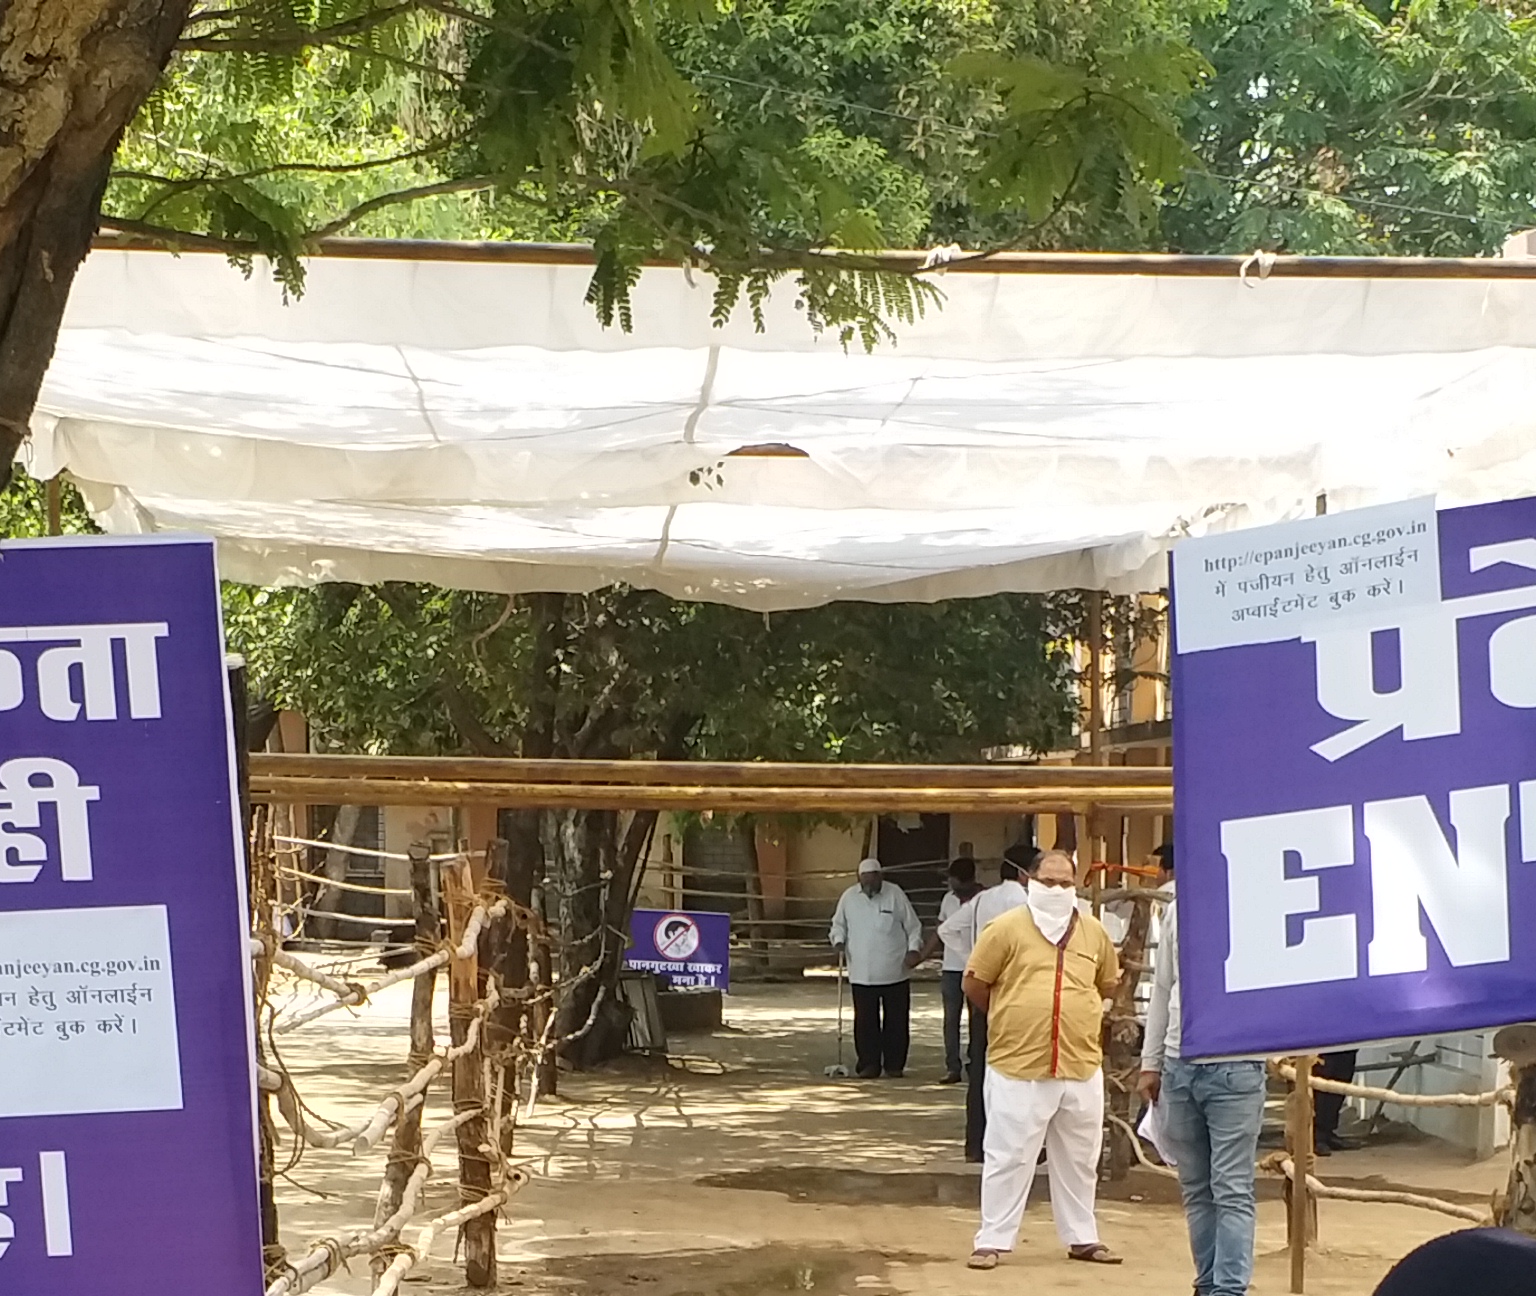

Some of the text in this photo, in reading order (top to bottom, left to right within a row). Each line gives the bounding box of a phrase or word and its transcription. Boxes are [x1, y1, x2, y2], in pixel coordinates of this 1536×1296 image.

[1204, 521, 1427, 573] http://epanjeeyan.cg.gov.in
[1215, 580, 1227, 597] में
[1304, 563, 1331, 584] हेतु
[1339, 547, 1418, 576] ऑनलाईन
[1329, 590, 1356, 610] बुक
[27, 985, 57, 1011] हेतु
[66, 983, 152, 1006] ऑनलाईन
[56, 1020, 85, 1040] बुक
